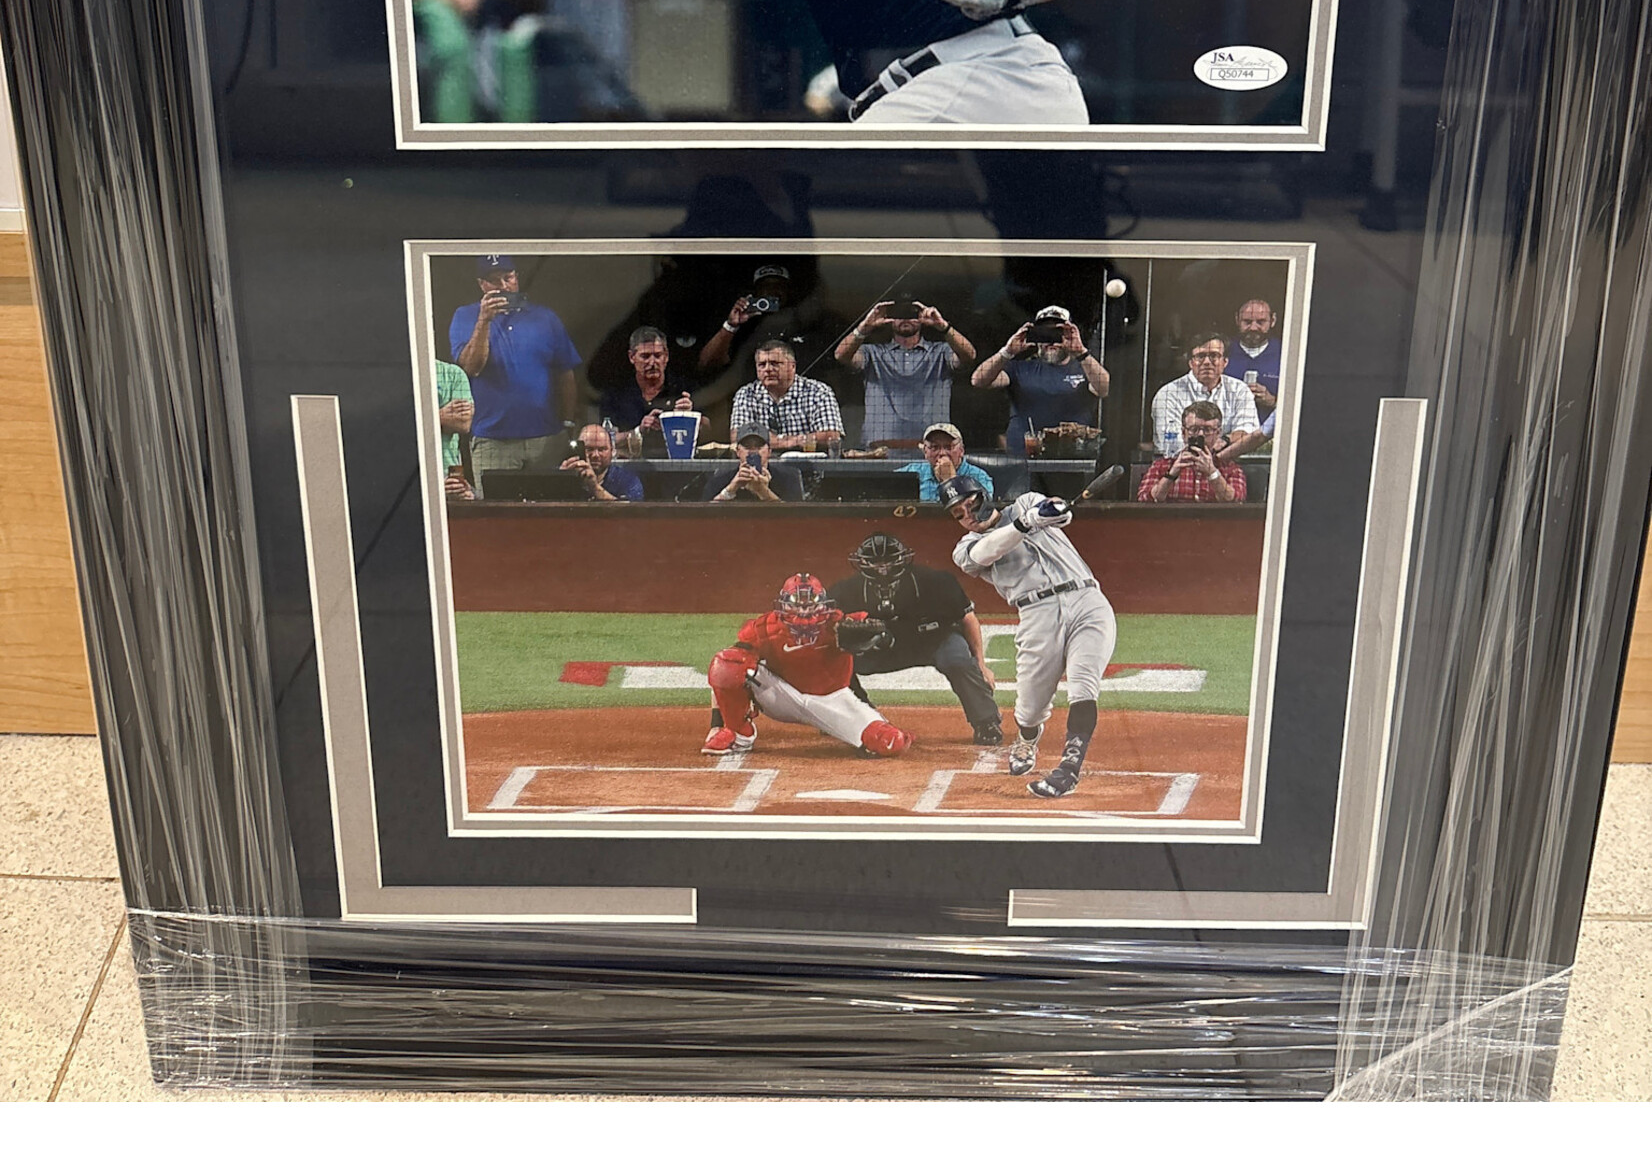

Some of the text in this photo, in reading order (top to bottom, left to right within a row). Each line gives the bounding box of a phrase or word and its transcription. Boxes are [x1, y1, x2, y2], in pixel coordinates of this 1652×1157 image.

[1211, 52, 1234, 64] JSA
[1218, 70, 1254, 80] Q50744
[671, 429, 688, 446] T
